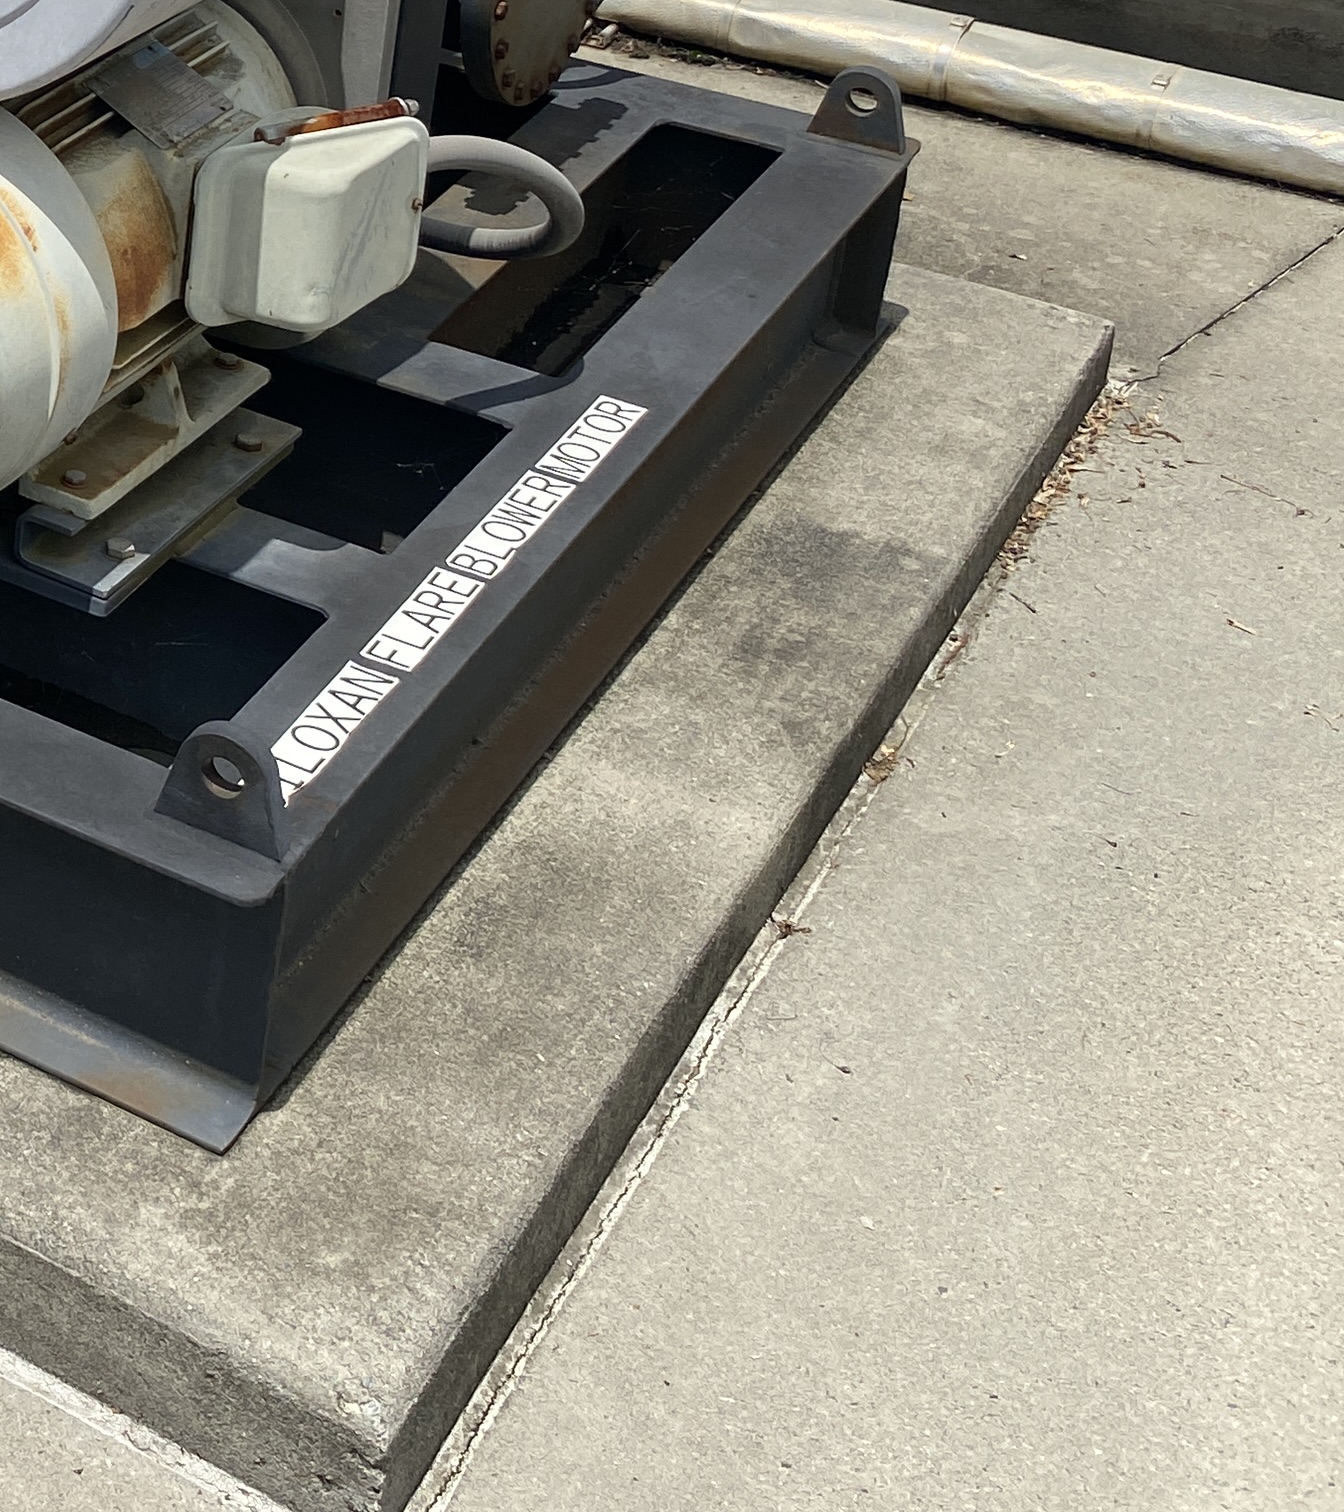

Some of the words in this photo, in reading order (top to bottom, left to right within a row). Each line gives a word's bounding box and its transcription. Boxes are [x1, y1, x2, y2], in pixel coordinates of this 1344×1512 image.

[365, 571, 480, 669] FLARE
[448, 474, 572, 578] BLOWER
[539, 400, 642, 480] MOTOR
